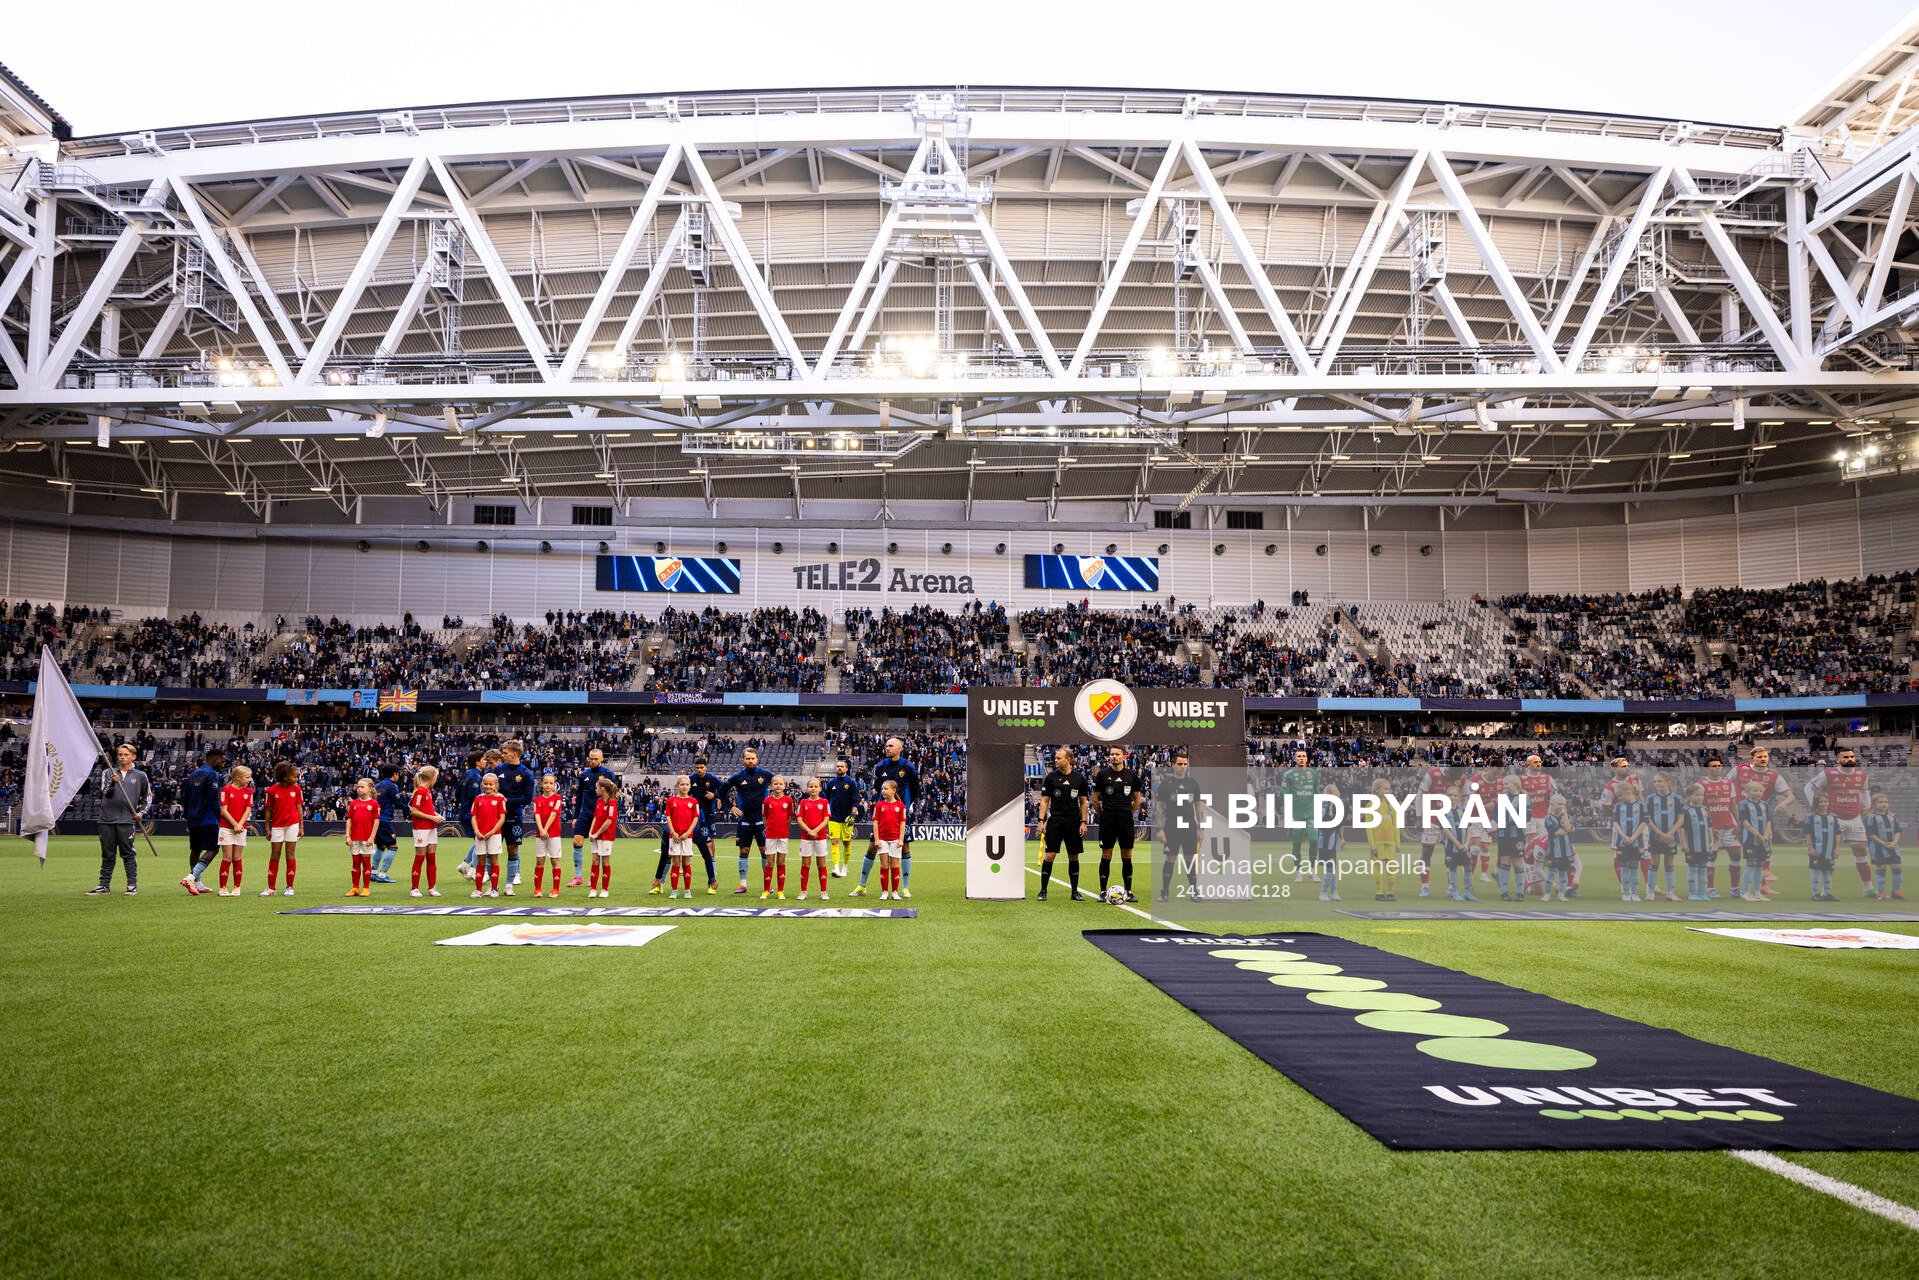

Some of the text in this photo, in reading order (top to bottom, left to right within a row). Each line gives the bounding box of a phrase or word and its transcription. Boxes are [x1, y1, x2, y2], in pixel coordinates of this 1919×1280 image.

[793, 558, 975, 594] TELE2 Arena
[982, 699, 1059, 717] UNIBET
[1152, 701, 1229, 718] UNIBET
[985, 835, 1006, 861] U
[402, 906, 893, 918] ALLSVENSKAN
[1422, 1085, 1798, 1107] UNIBET
